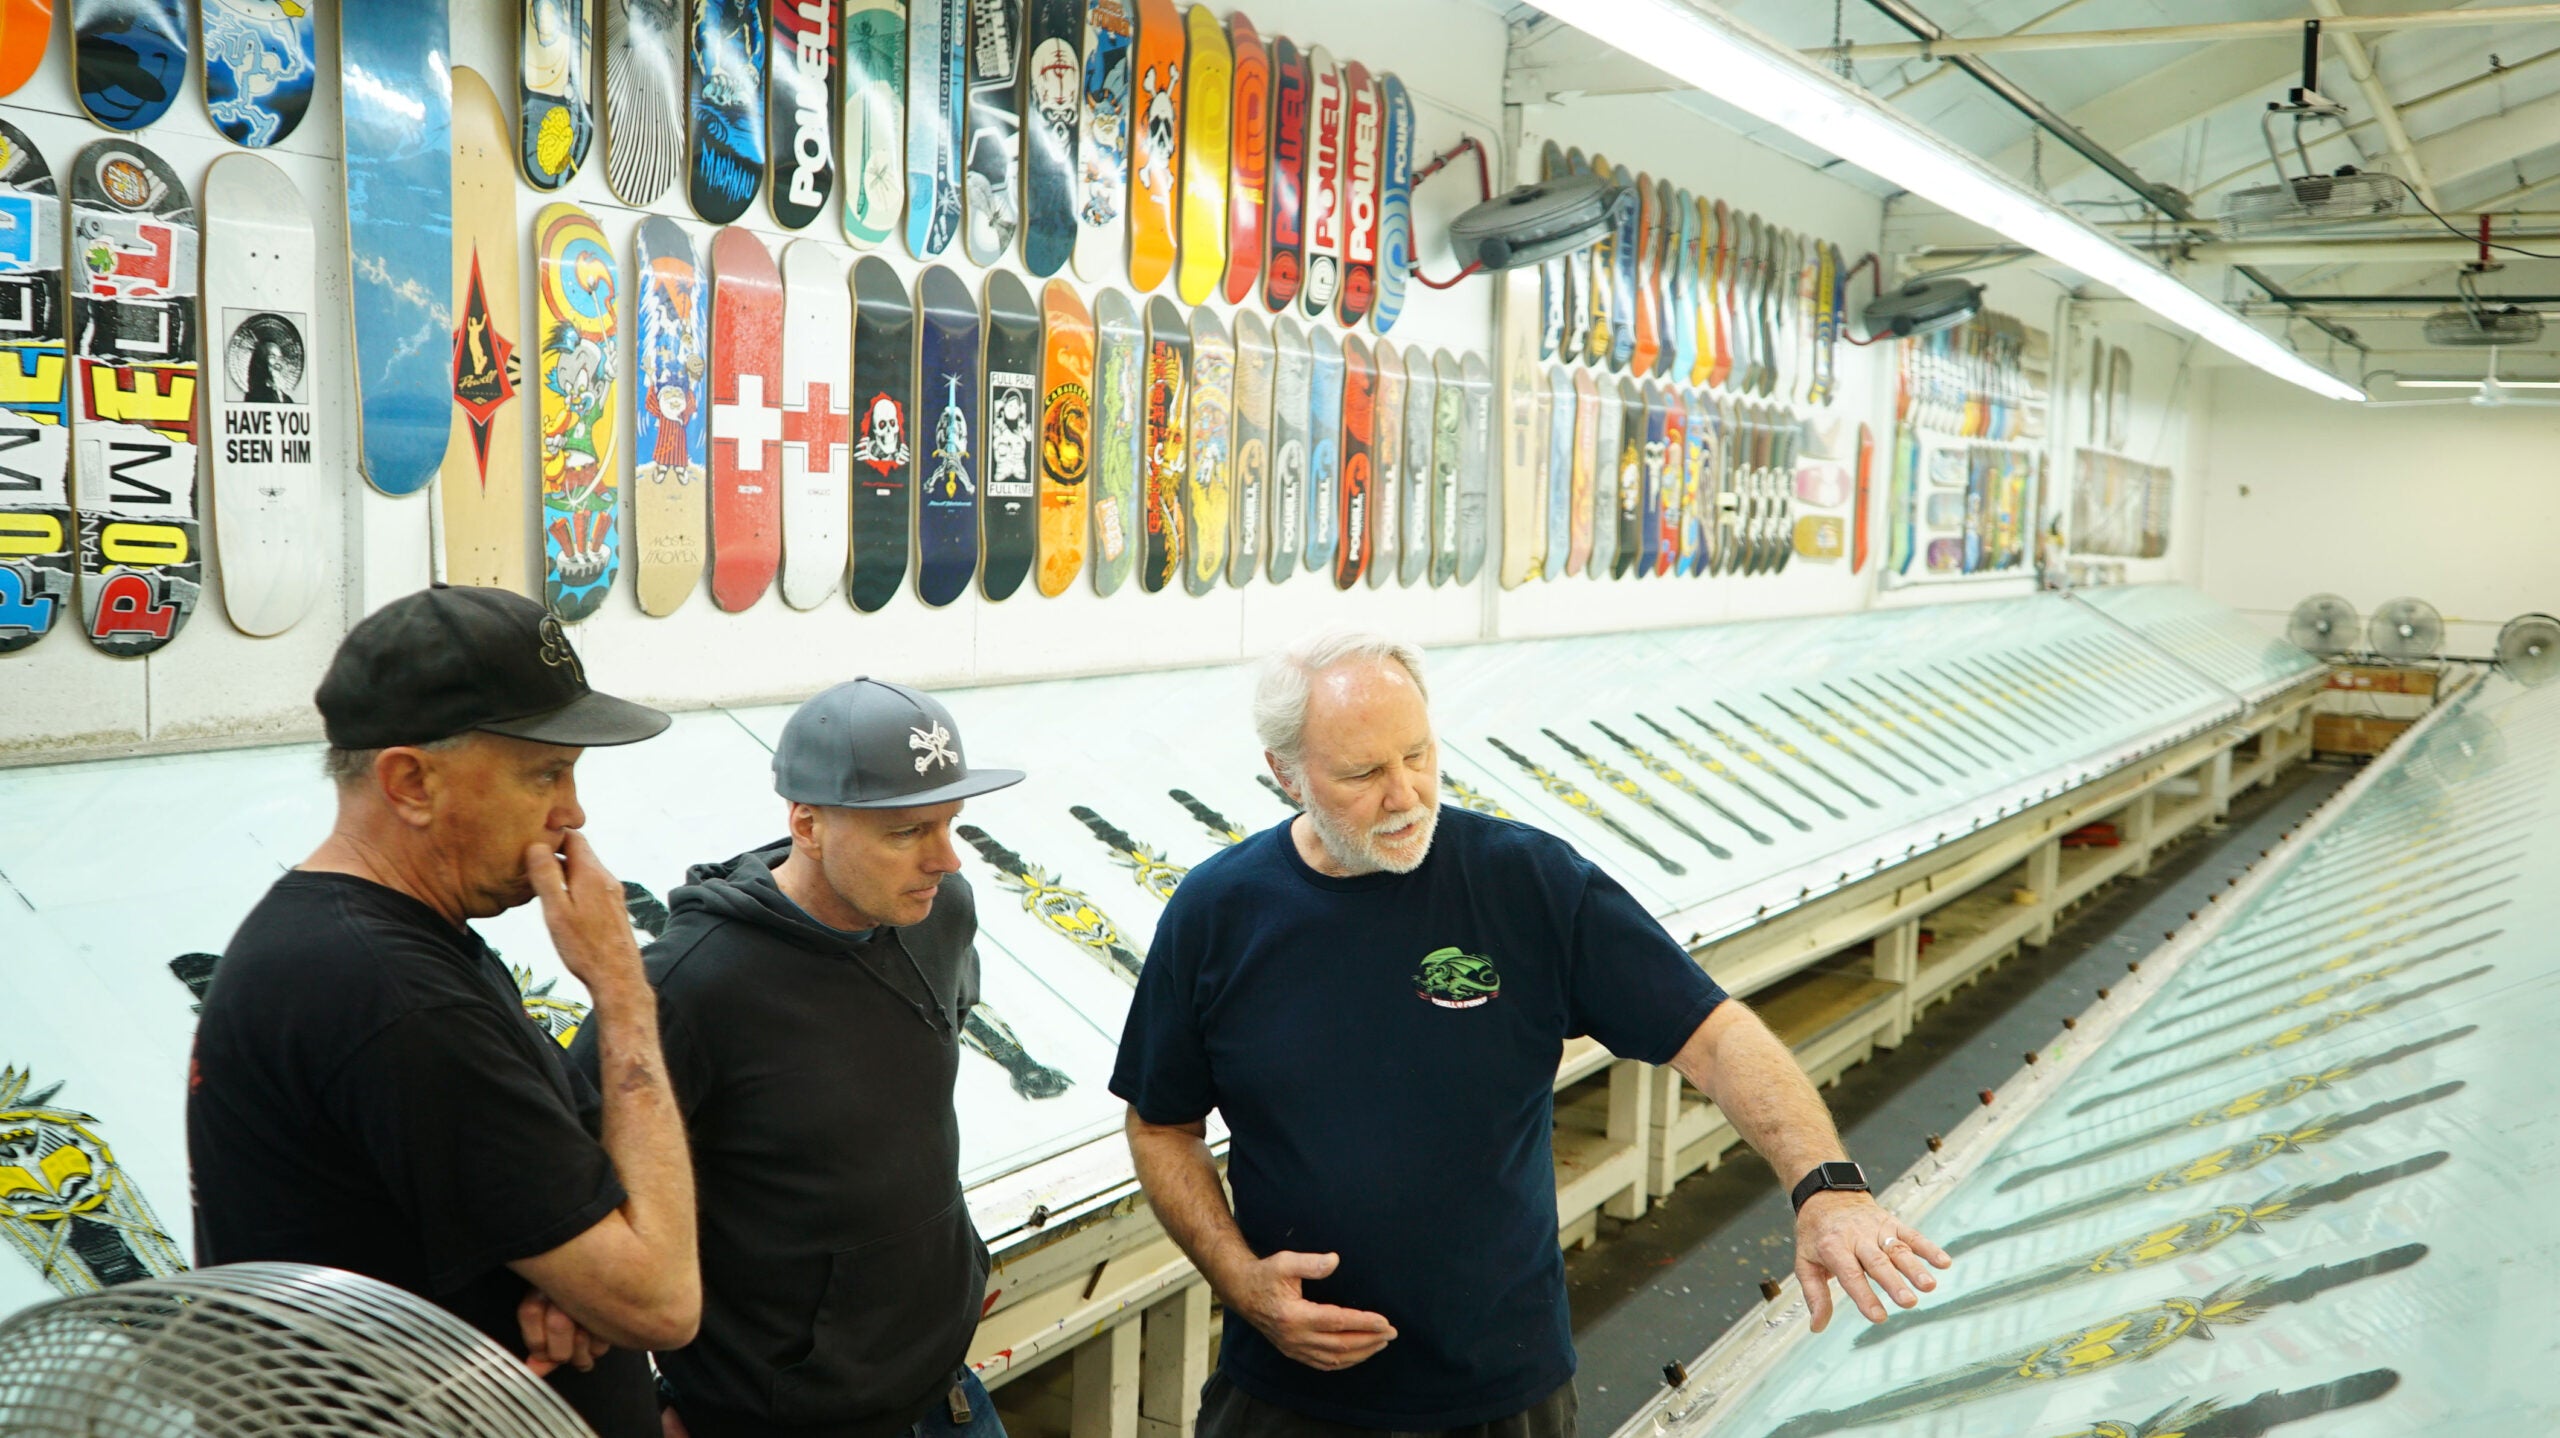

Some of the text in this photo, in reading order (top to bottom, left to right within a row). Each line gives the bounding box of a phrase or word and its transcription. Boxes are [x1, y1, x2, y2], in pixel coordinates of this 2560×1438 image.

[1275, 57, 1306, 246] POWELL
[1316, 64, 1342, 249] POWELL
[1350, 77, 1378, 261] POWELL
[1393, 93, 1410, 184] POWELL
[225, 410, 310, 435] HAVE YOU
[226, 439, 311, 463] SEEN HIM
[989, 484, 1011, 494] FULL
[1349, 493, 1363, 561] POWELL
